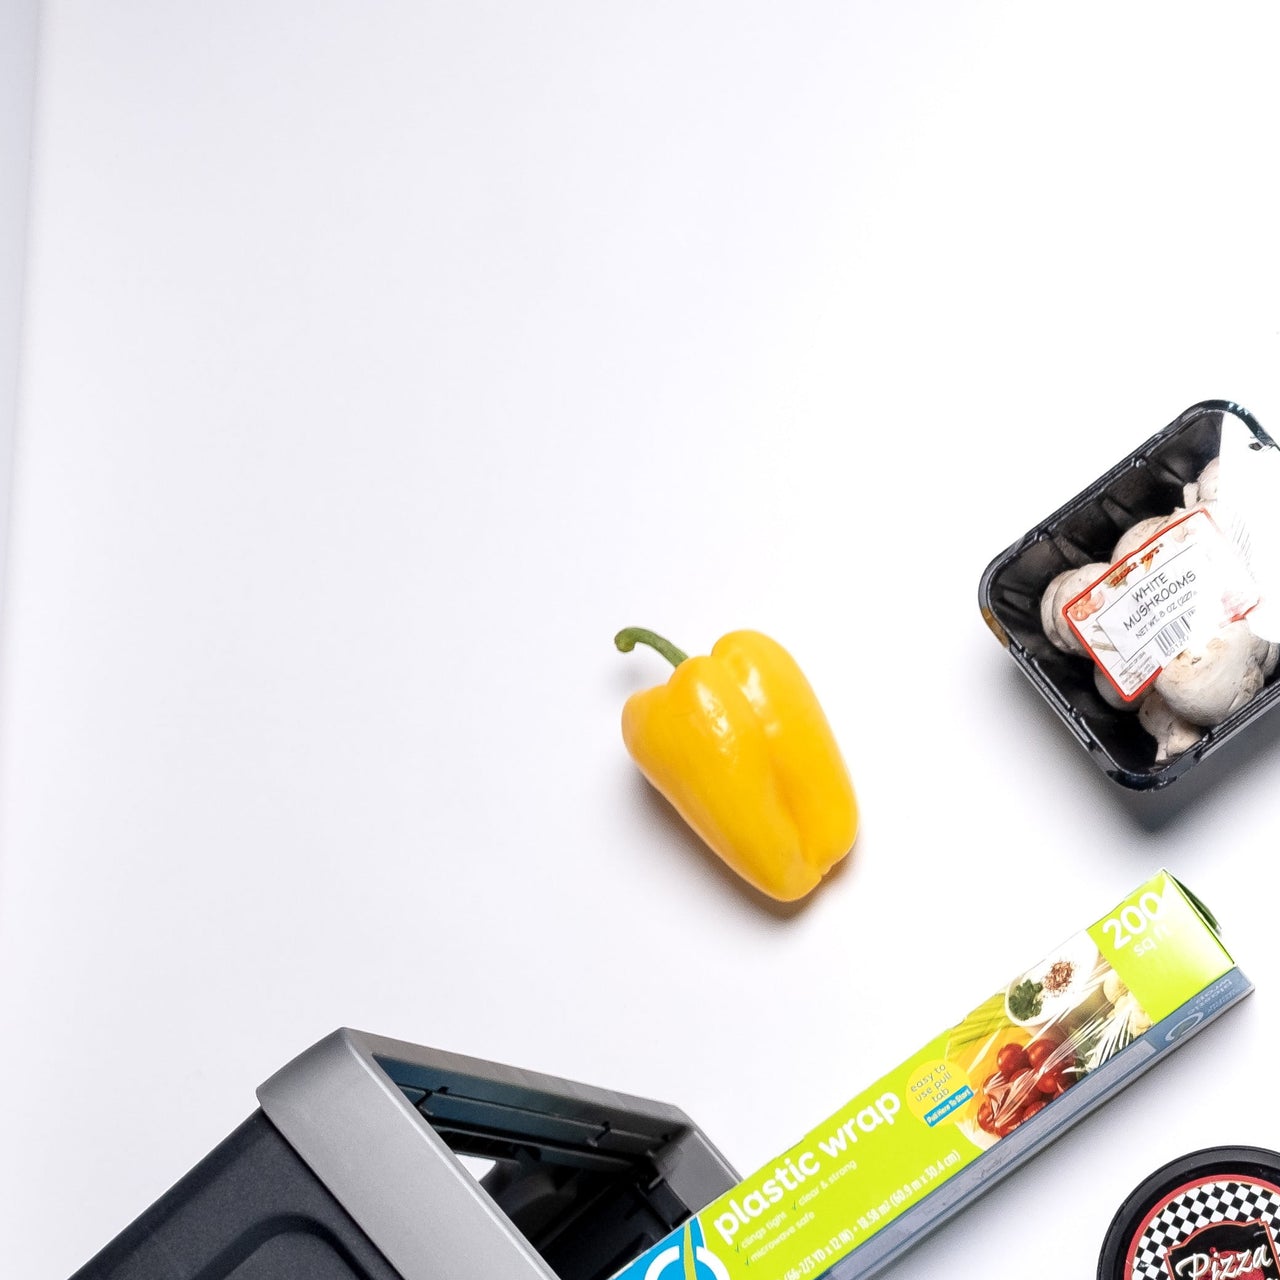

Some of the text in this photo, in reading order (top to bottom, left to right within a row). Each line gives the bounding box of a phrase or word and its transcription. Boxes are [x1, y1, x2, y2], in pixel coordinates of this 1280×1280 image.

[1131, 572, 1167, 602] WHITE
[1123, 571, 1195, 629] MUSHROOMS
[1135, 624, 1148, 638] NET
[1103, 892, 1172, 947] 200
[910, 1073, 933, 1092] easy
[934, 1071, 951, 1089] pull
[931, 1088, 949, 1102] tab
[712, 1093, 899, 1243] plastic wrap
[828, 1160, 856, 1183] strong
[741, 1228, 765, 1247] clings
